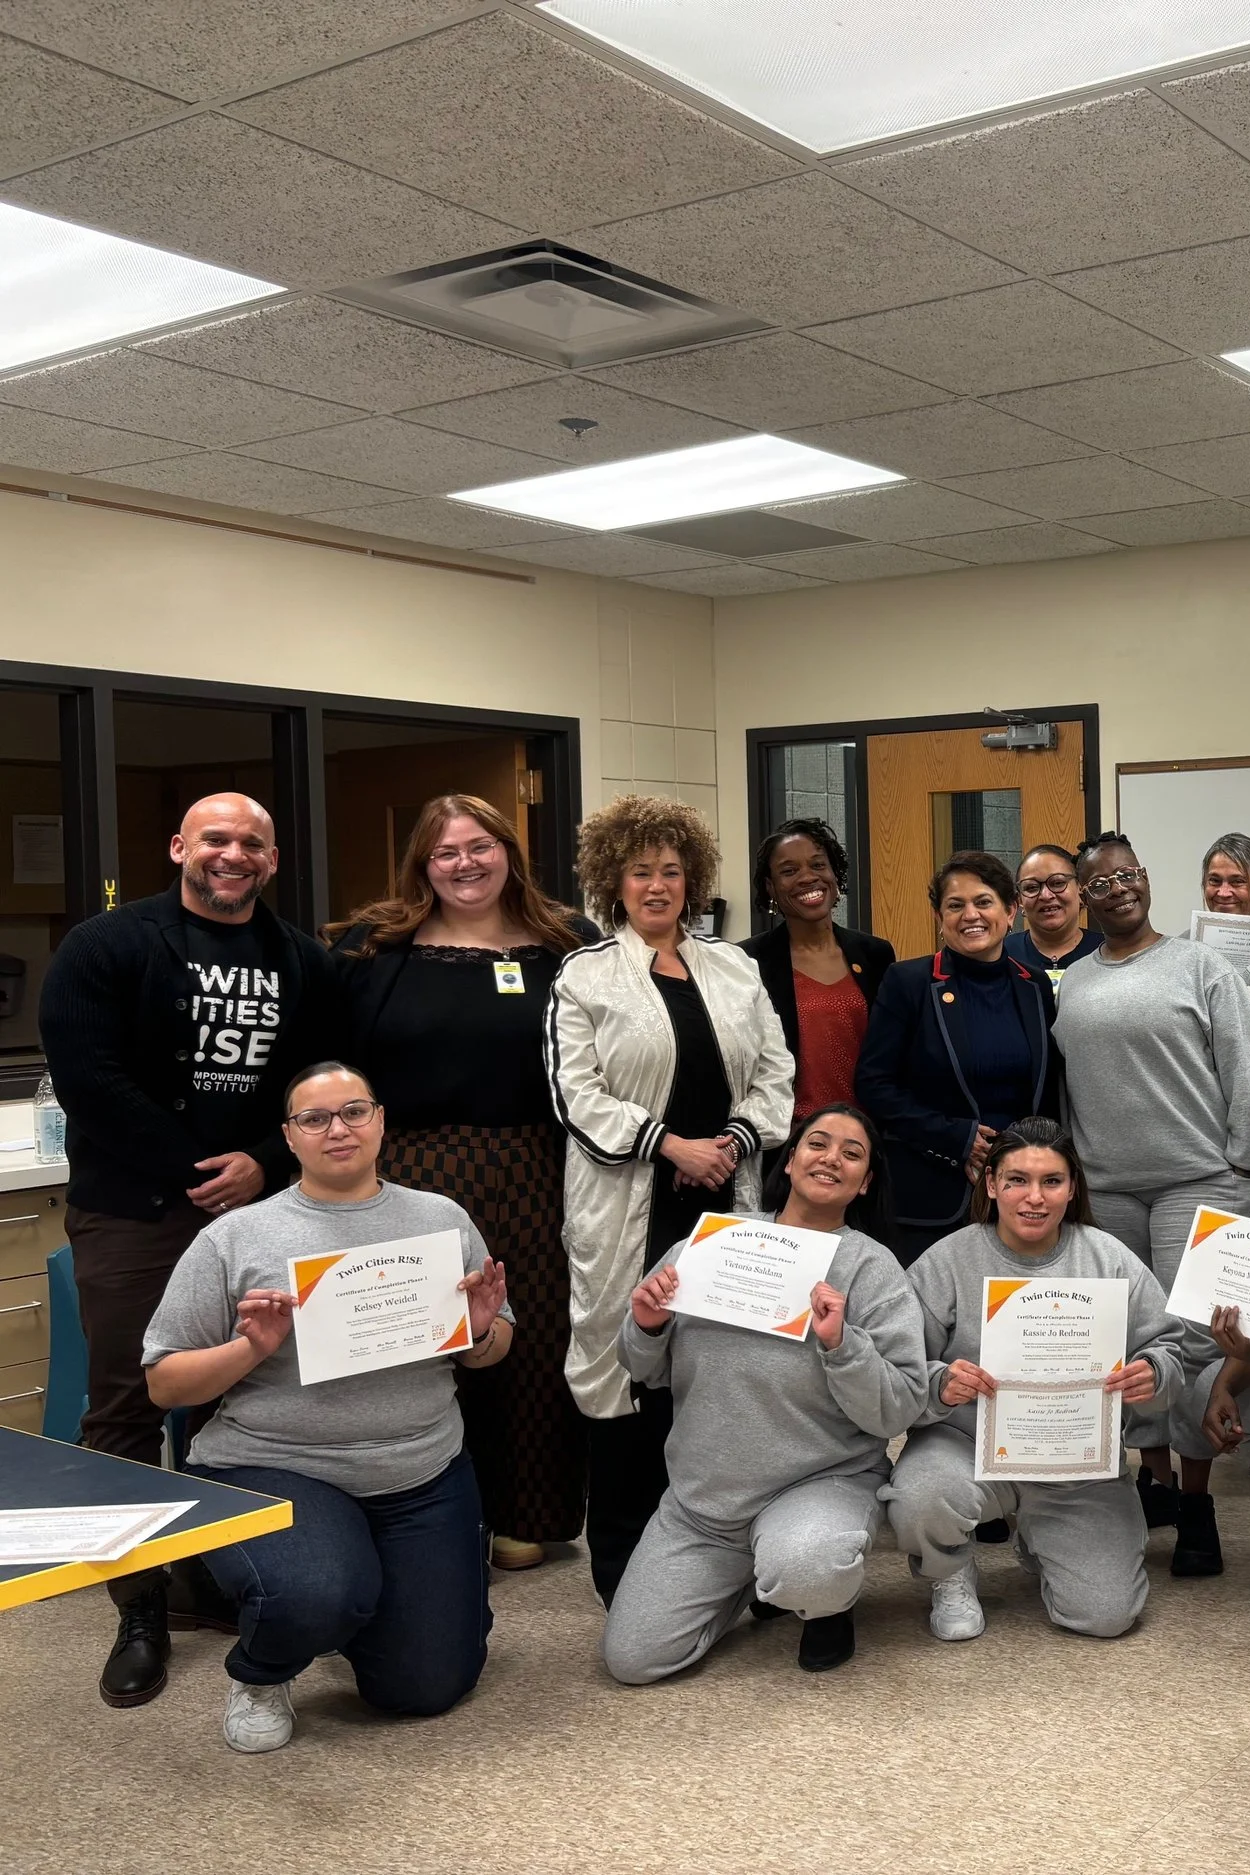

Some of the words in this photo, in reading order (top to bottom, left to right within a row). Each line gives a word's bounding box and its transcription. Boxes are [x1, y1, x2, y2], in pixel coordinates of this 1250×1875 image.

[192, 995, 280, 1027] ITIES
[194, 1024, 277, 1066] !SE
[731, 1230, 752, 1238] Twin
[755, 1231, 778, 1241] Cities
[1225, 1232, 1244, 1240] Twin
[336, 1264, 363, 1279] Twin
[365, 1257, 395, 1268] Cities
[398, 1255, 423, 1265] R!SE
[725, 1259, 752, 1272] Victoria
[336, 1289, 366, 1298] Certificate
[374, 1280, 406, 1290] Completion
[1020, 1292, 1042, 1303] Twin
[1045, 1290, 1069, 1298] Cities
[1072, 1292, 1093, 1304] R!SE
[354, 1300, 382, 1313] Kelsey
[384, 1293, 418, 1306] Weidell
[1023, 1329, 1046, 1337] Kassie
[1048, 1329, 1057, 1337] Jo
[1059, 1329, 1090, 1337] Redroad
